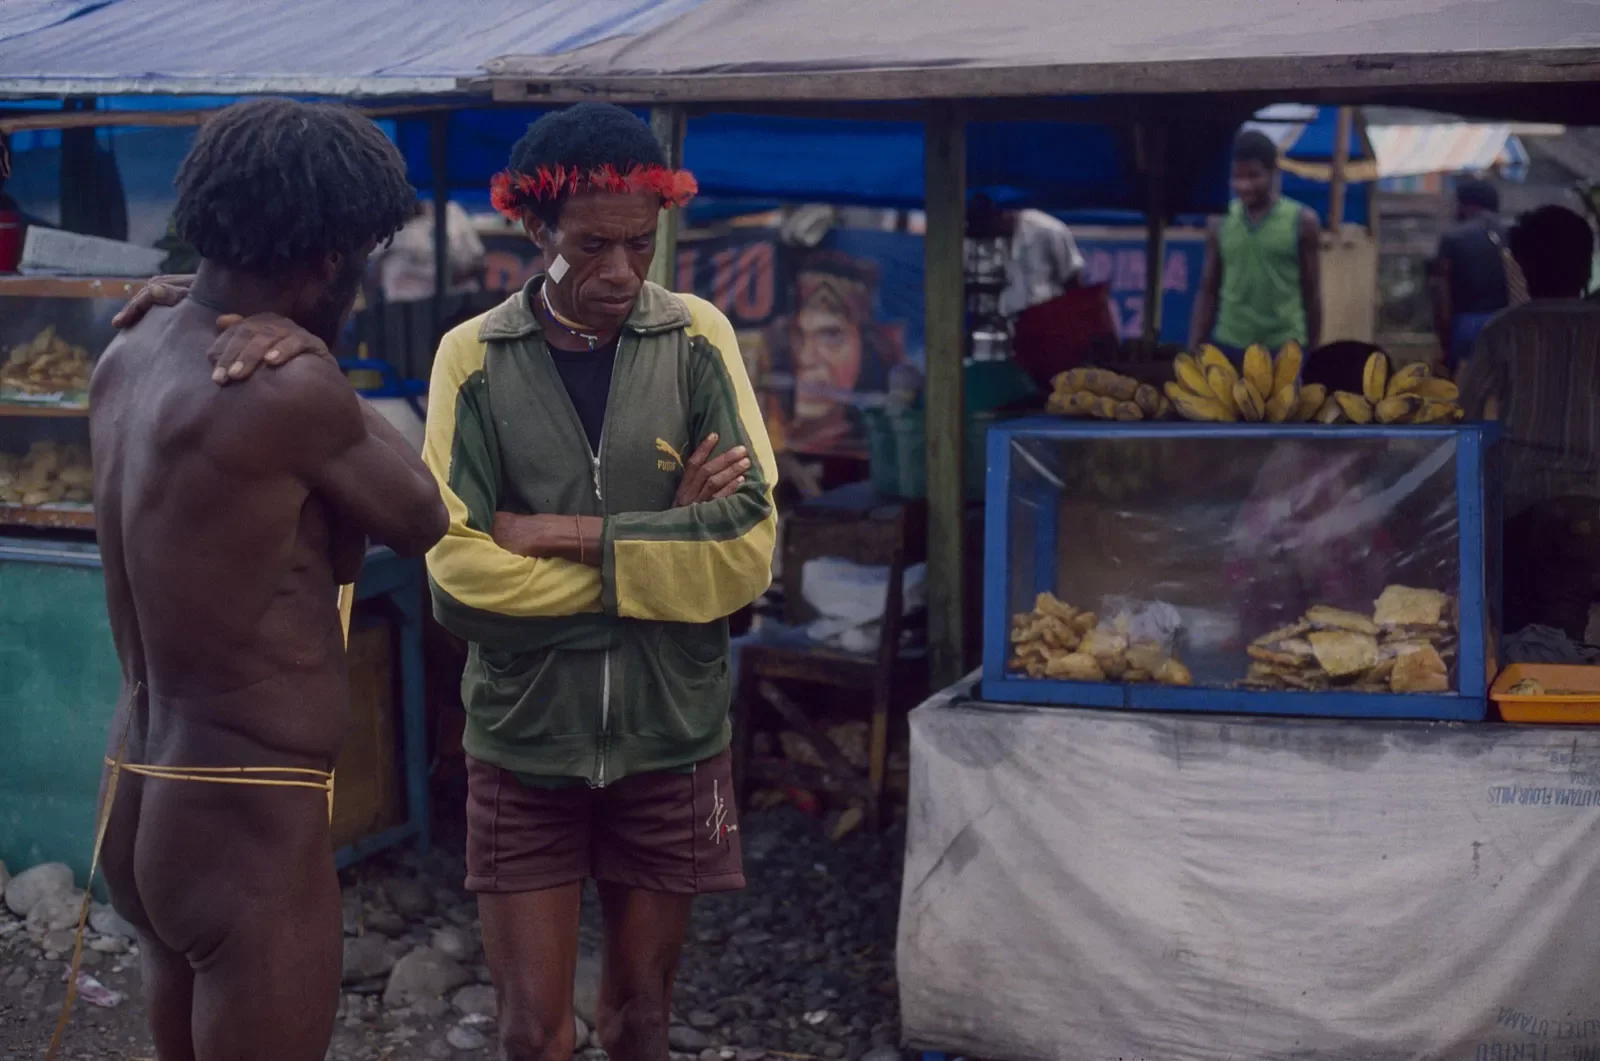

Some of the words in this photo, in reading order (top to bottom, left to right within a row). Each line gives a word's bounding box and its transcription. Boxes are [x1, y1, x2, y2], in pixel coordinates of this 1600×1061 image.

[1486, 786, 1517, 805] MILLS
[1517, 787, 1553, 805] FLOUR
[1555, 788, 1592, 807] UTAMA
[1495, 1006, 1549, 1041] UTAMA
